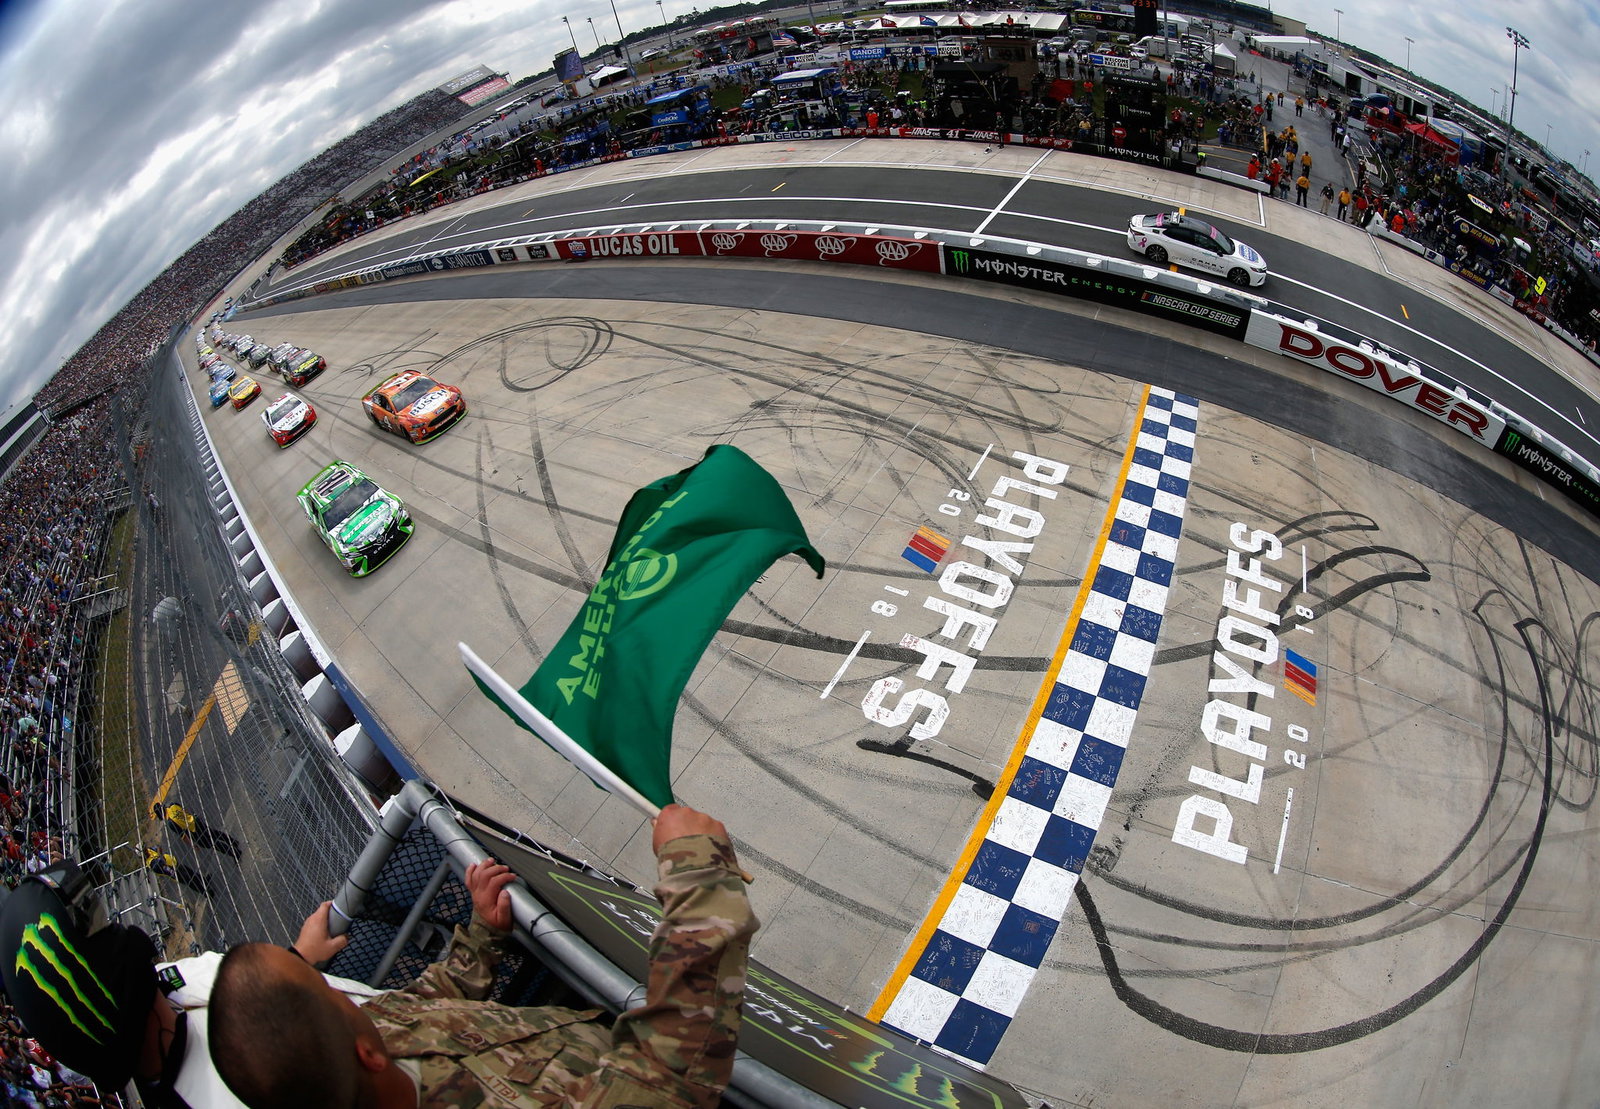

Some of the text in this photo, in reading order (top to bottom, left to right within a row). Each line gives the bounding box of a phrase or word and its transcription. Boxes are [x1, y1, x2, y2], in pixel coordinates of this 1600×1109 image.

[774, 131, 811, 140] GEICO
[946, 129, 960, 138] 41
[1108, 146, 1160, 161] MONSTER
[589, 236, 643, 257] LUCAS
[647, 234, 680, 255] OIL
[714, 234, 736, 249] AAA
[762, 235, 786, 250] AAA
[817, 238, 845, 254] AAA
[878, 242, 908, 260] AAA
[445, 252, 487, 269] SEAWATCH
[975, 258, 1136, 296] MONSTER ENERGY
[1534, 276, 1547, 295] 9
[1152, 295, 1241, 327] NASCAR CUP SERIES
[1278, 323, 1489, 438] DOVER
[409, 388, 448, 416] BUSCH
[1518, 444, 1600, 503] MONSTER ENERG
[870, 488, 971, 618] 20 18
[860, 450, 1070, 741] PLAYOFFS
[1171, 521, 1283, 865] PLAYOFFS
[1283, 603, 1315, 770] 20 18
[482, 1074, 520, 1101] KELLY
